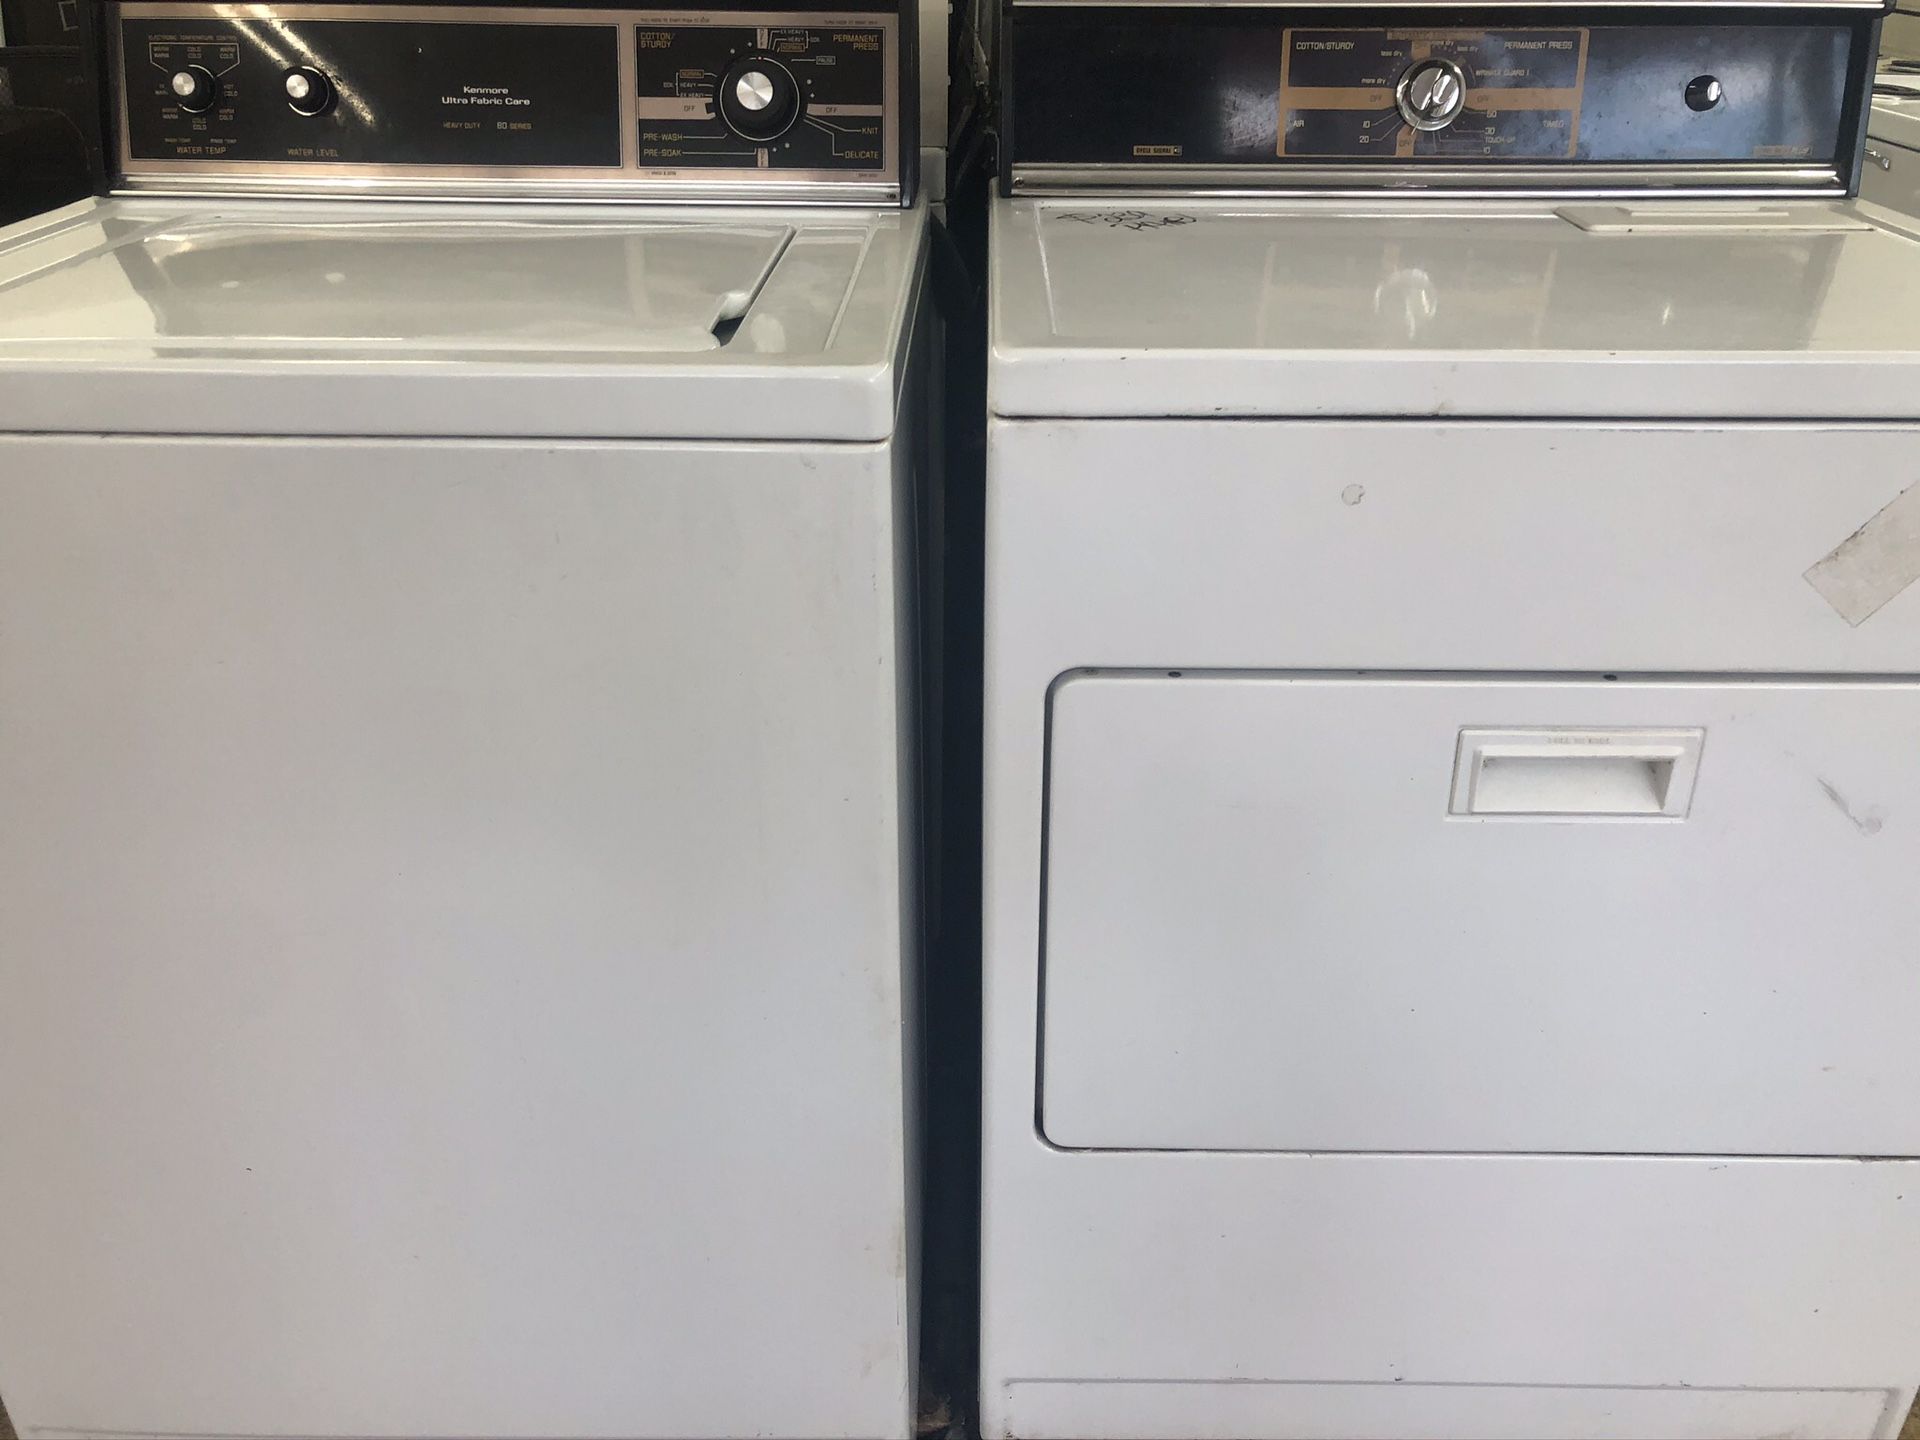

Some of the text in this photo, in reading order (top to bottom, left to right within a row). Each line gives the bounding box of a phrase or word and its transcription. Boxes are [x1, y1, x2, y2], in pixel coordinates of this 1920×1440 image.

[833, 34, 879, 42] PERMANENT
[640, 40, 672, 48] STURDY
[1504, 41, 1573, 49] PERMANENT PRESS
[463, 86, 509, 94] Kenmore
[470, 97, 503, 105] Fabric
[505, 97, 531, 105] Care
[443, 121, 463, 129] HEAVY
[1362, 120, 1371, 128] 10
[643, 133, 683, 141] PRE-WASH
[176, 146, 202, 154] WATER
[288, 148, 313, 156] WATER
[643, 148, 682, 157] PRE-SOAK
[845, 150, 879, 159] DELICATE
